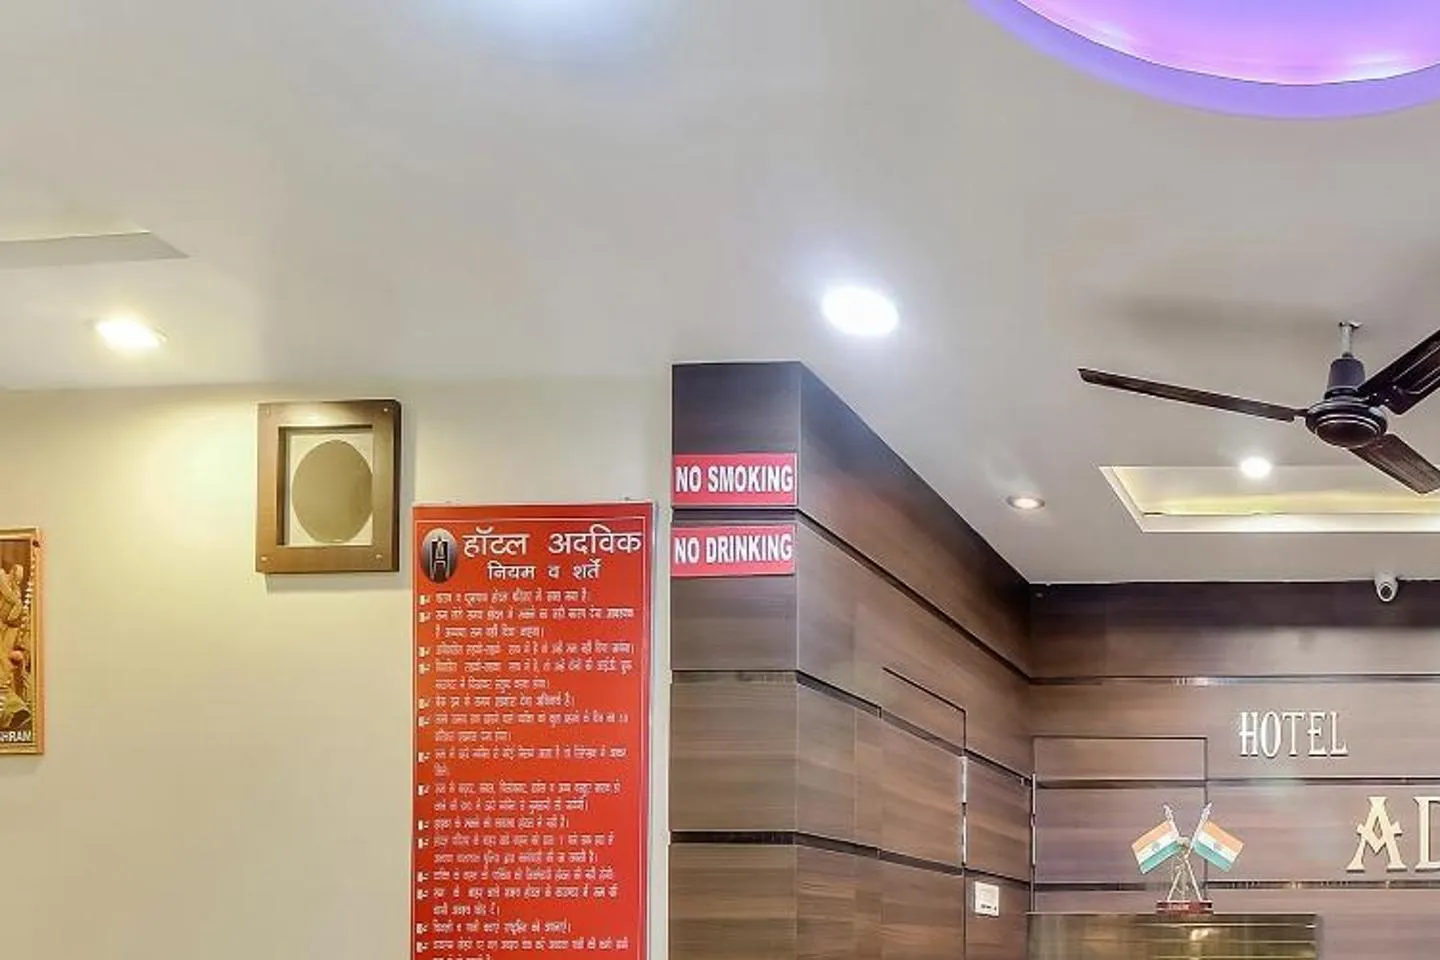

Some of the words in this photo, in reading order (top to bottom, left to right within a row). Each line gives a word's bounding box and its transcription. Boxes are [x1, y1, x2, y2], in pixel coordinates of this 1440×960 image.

[675, 465, 702, 493] NO
[707, 464, 794, 493] SMOKING
[548, 523, 643, 556] अदविक
[674, 536, 700, 565] NO
[705, 533, 793, 564] DRINKING
[1238, 710, 1349, 758] HOTEL
